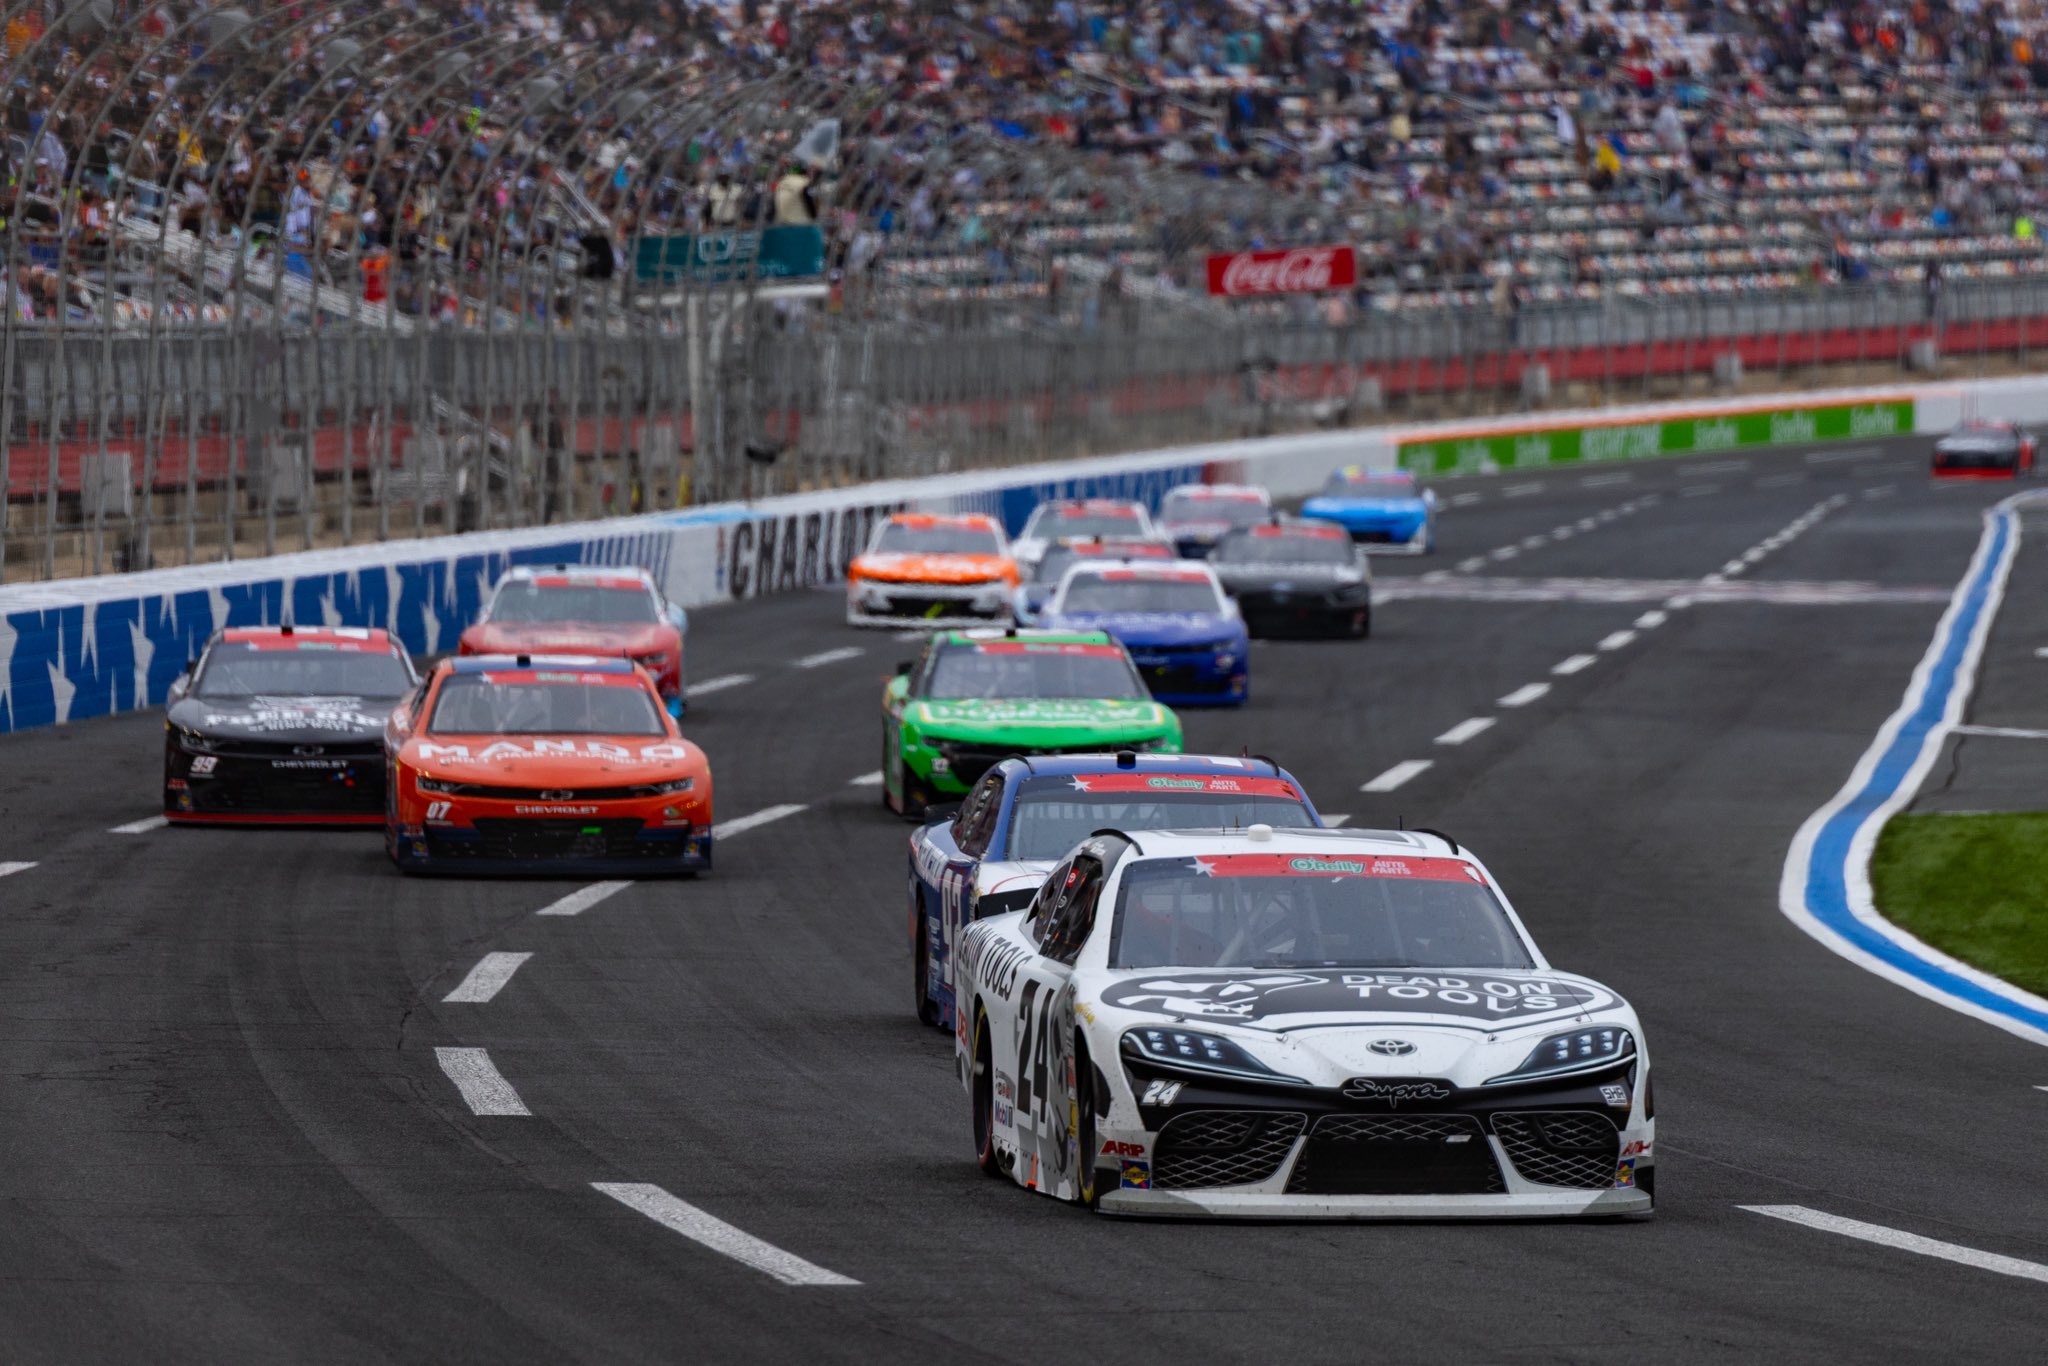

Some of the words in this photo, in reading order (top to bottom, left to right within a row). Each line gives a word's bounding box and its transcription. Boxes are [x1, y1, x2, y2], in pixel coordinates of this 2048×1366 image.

[418, 739, 686, 760] MANDO
[190, 756, 218, 773] 99
[271, 760, 348, 768] CHEVROLET
[1146, 777, 1205, 790] O'Reilly
[426, 802, 452, 819] 07
[515, 805, 599, 815] CHEVROLET
[1288, 856, 1366, 874] O'Reilly
[1374, 860, 1406, 868] AUTO
[1371, 867, 1411, 875] PARTS
[1341, 974, 1469, 989] DEAD
[1483, 981, 1551, 998] ON
[1346, 985, 1557, 1012] TOOLS
[1016, 978, 1056, 1124] 24
[1141, 1080, 1184, 1107] 24
[1343, 1079, 1449, 1109] Supra
[1100, 1140, 1145, 1156] ARP
